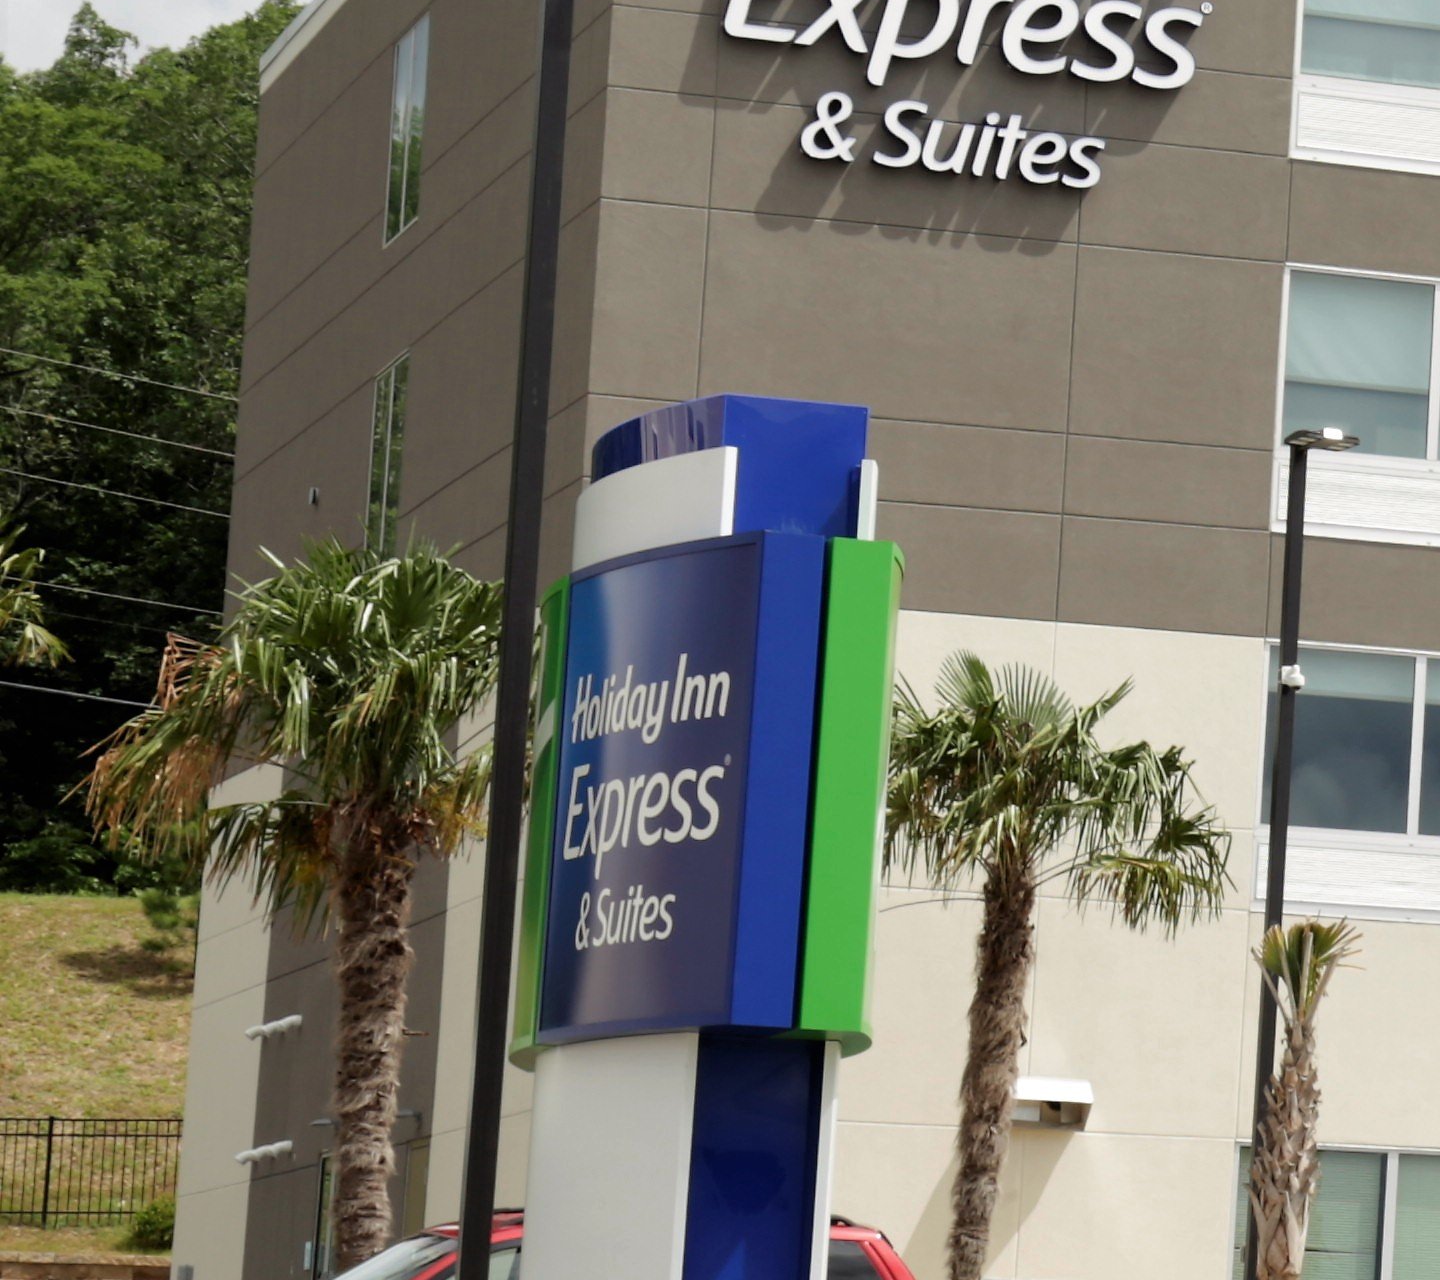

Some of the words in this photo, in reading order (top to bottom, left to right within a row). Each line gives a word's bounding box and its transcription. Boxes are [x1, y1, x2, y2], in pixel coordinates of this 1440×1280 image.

[800, 91, 858, 164] &
[873, 99, 1106, 190] Suites
[571, 664, 669, 745] Holiday
[670, 653, 731, 724] Inn
[574, 891, 591, 951] &
[592, 884, 676, 947] Suites
